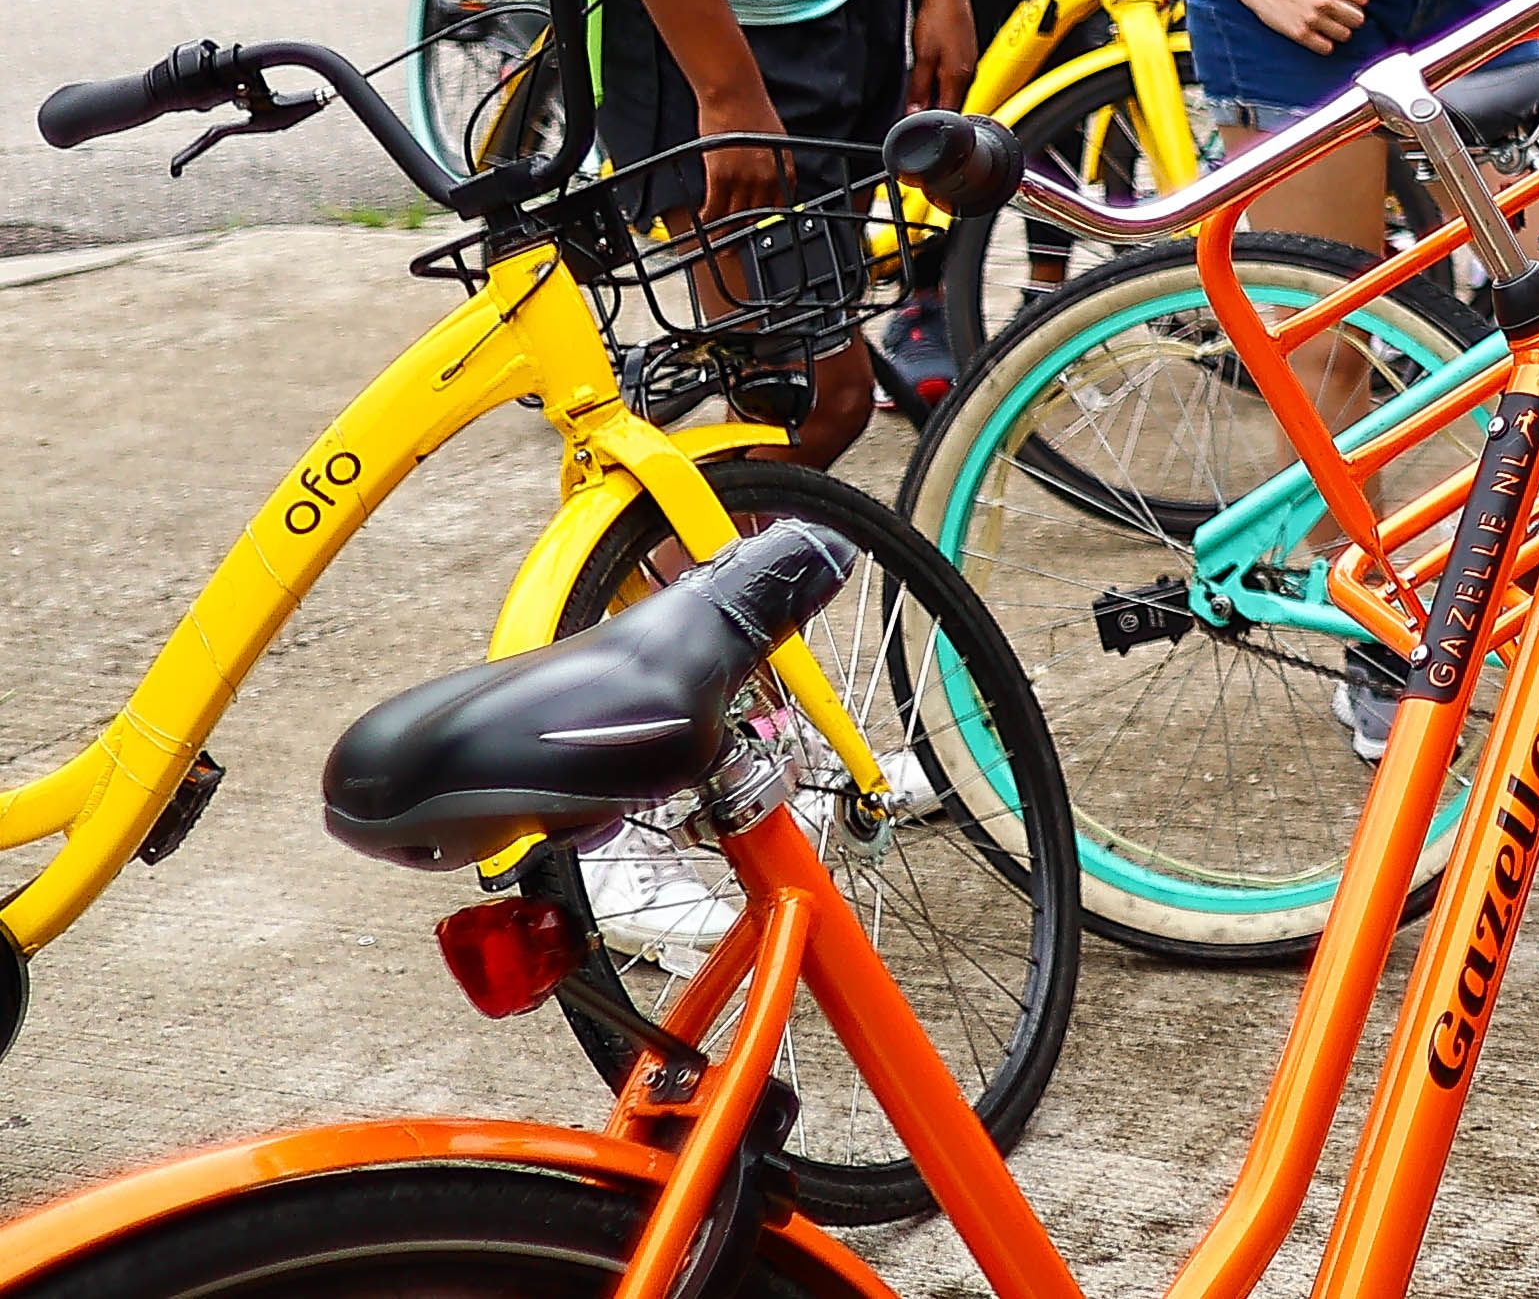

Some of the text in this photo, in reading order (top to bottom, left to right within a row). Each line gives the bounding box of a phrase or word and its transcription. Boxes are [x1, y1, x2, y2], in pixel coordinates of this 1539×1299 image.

[285, 452, 361, 535] ofo
[1426, 452, 1530, 688] GAZELLE NL
